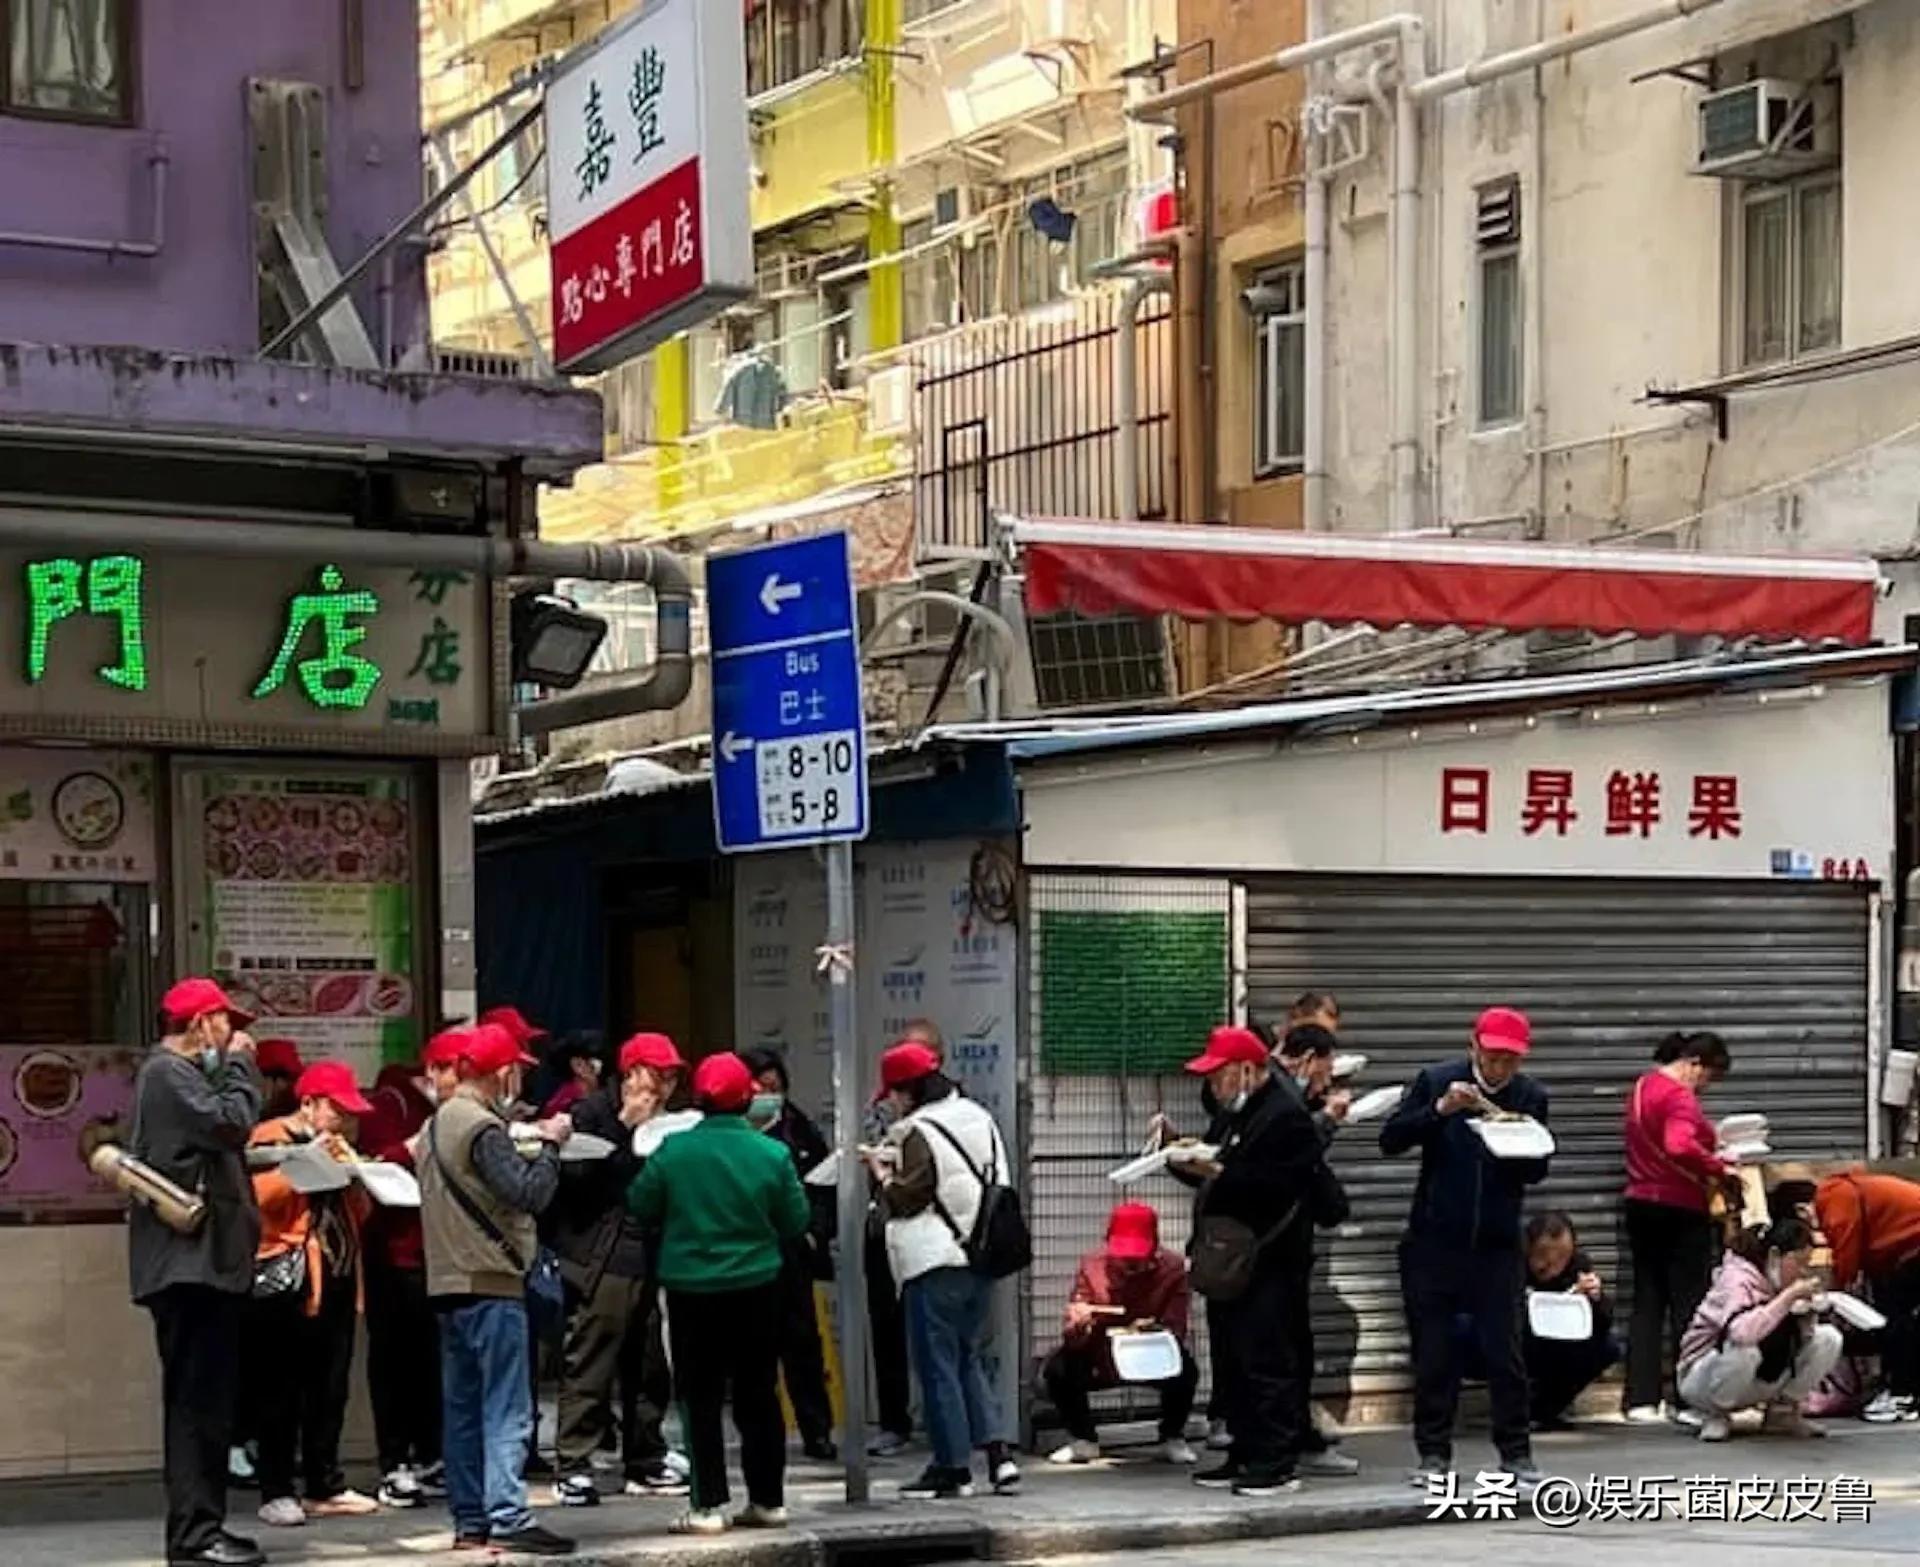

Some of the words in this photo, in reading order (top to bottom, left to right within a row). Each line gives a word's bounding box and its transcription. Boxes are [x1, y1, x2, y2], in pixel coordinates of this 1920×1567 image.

[575, 44, 667, 203] 嘉豐
[559, 197, 695, 328] 點心專門店
[785, 650, 820, 677] Bus
[779, 688, 827, 726] 巴士
[789, 739, 852, 779] 8-10
[791, 787, 840, 825] 5-8
